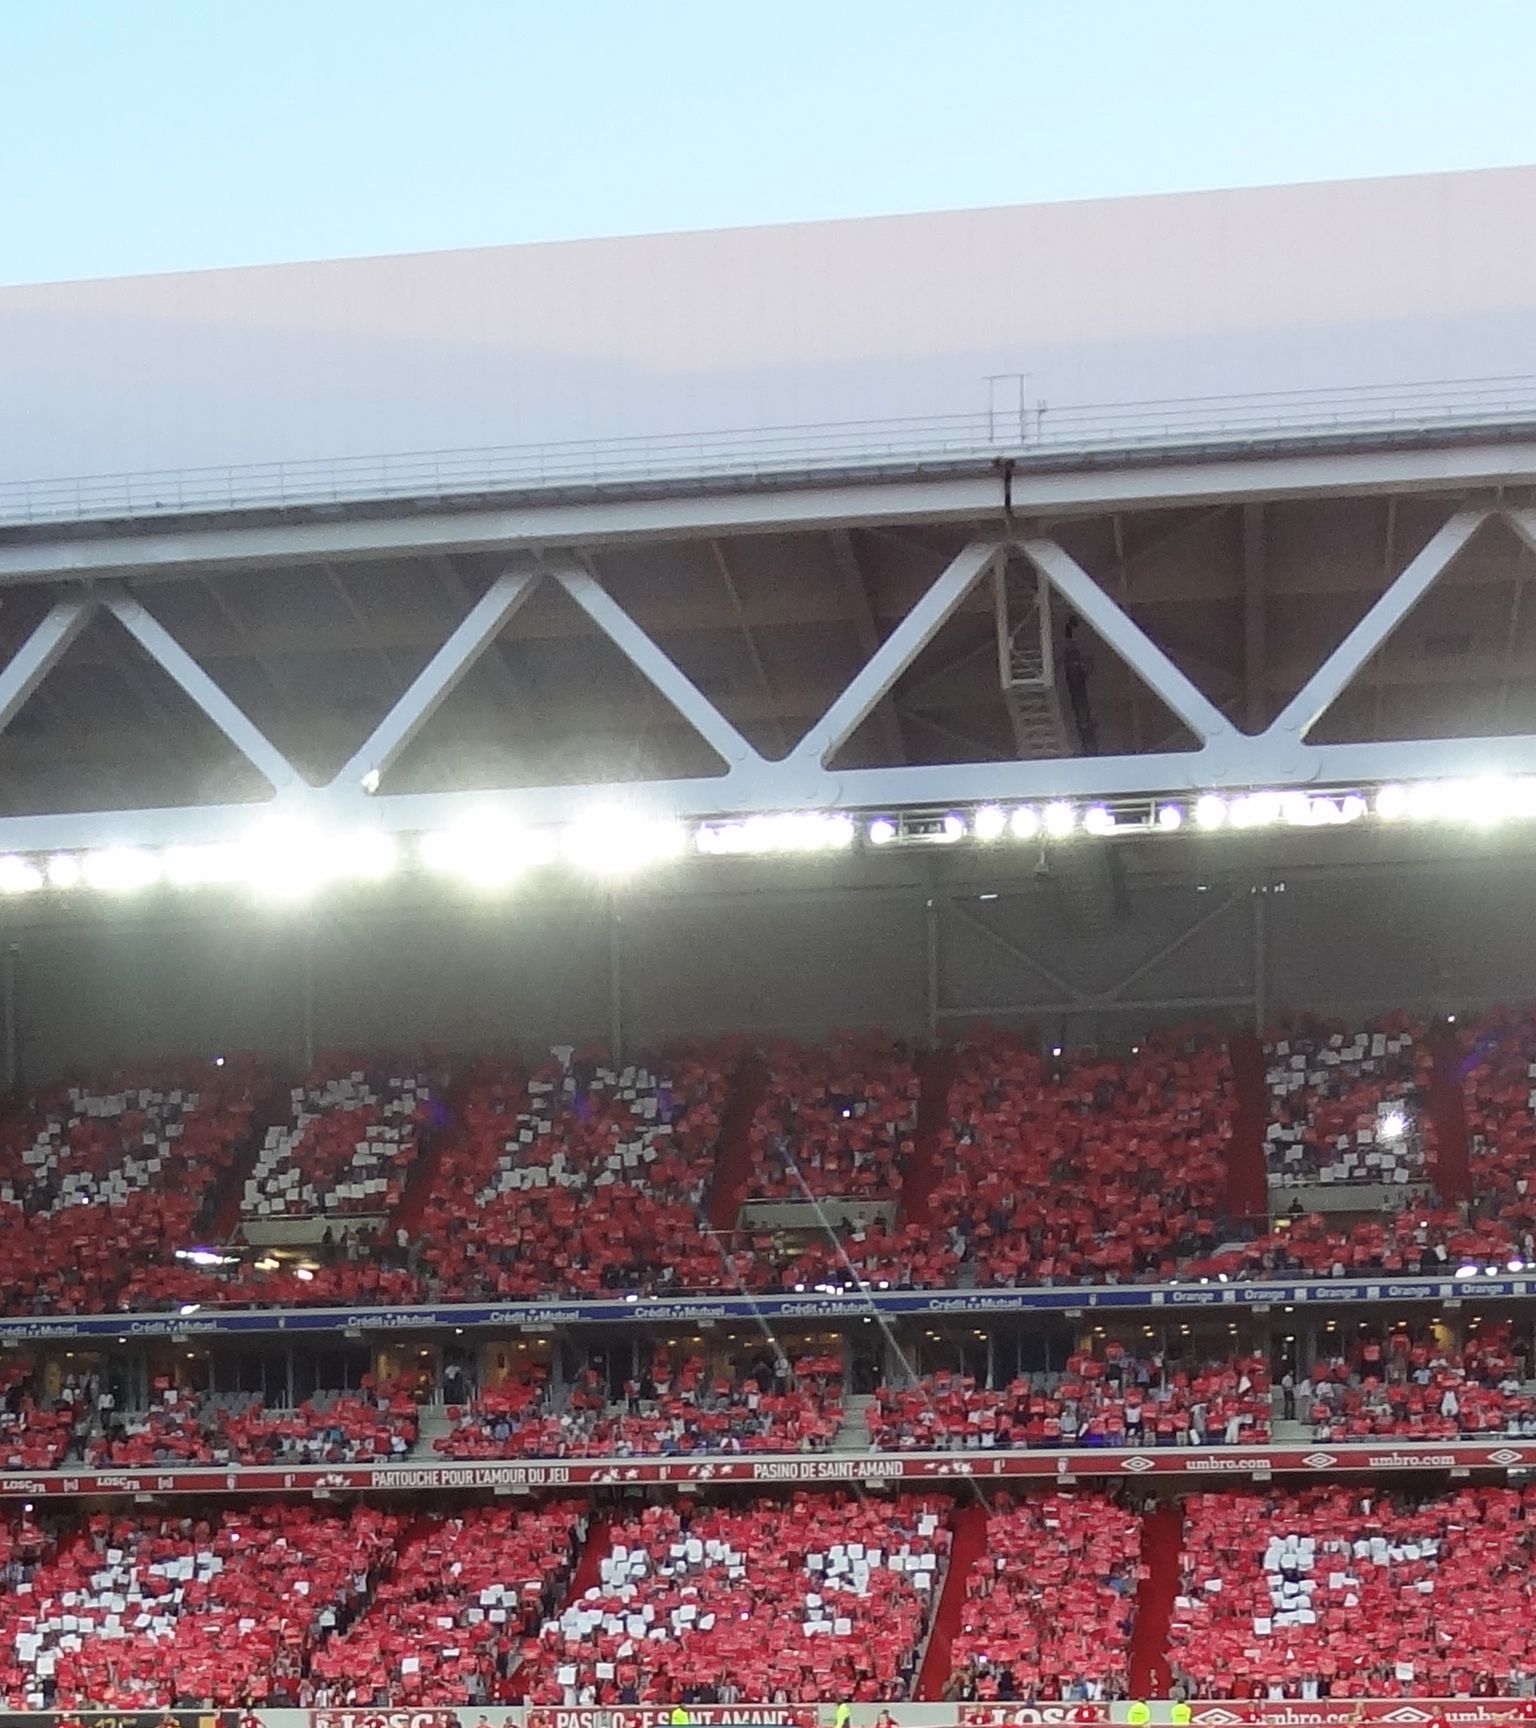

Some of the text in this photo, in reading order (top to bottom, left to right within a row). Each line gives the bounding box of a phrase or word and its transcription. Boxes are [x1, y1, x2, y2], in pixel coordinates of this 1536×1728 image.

[1244, 1288, 1286, 1300] Orange
[1316, 1287, 1358, 1299] Orange
[1389, 1285, 1431, 1297] Orange
[1462, 1282, 1504, 1295] Orange
[1173, 1290, 1214, 1302] Orange
[1186, 1456, 1271, 1470] umbro.com
[1369, 1453, 1455, 1467] umbro.com
[372, 1467, 569, 1486] PARTOUCHE POUR L'AMOUR DU JEU
[754, 1461, 903, 1479] PASINO DE SAINT-AMAND
